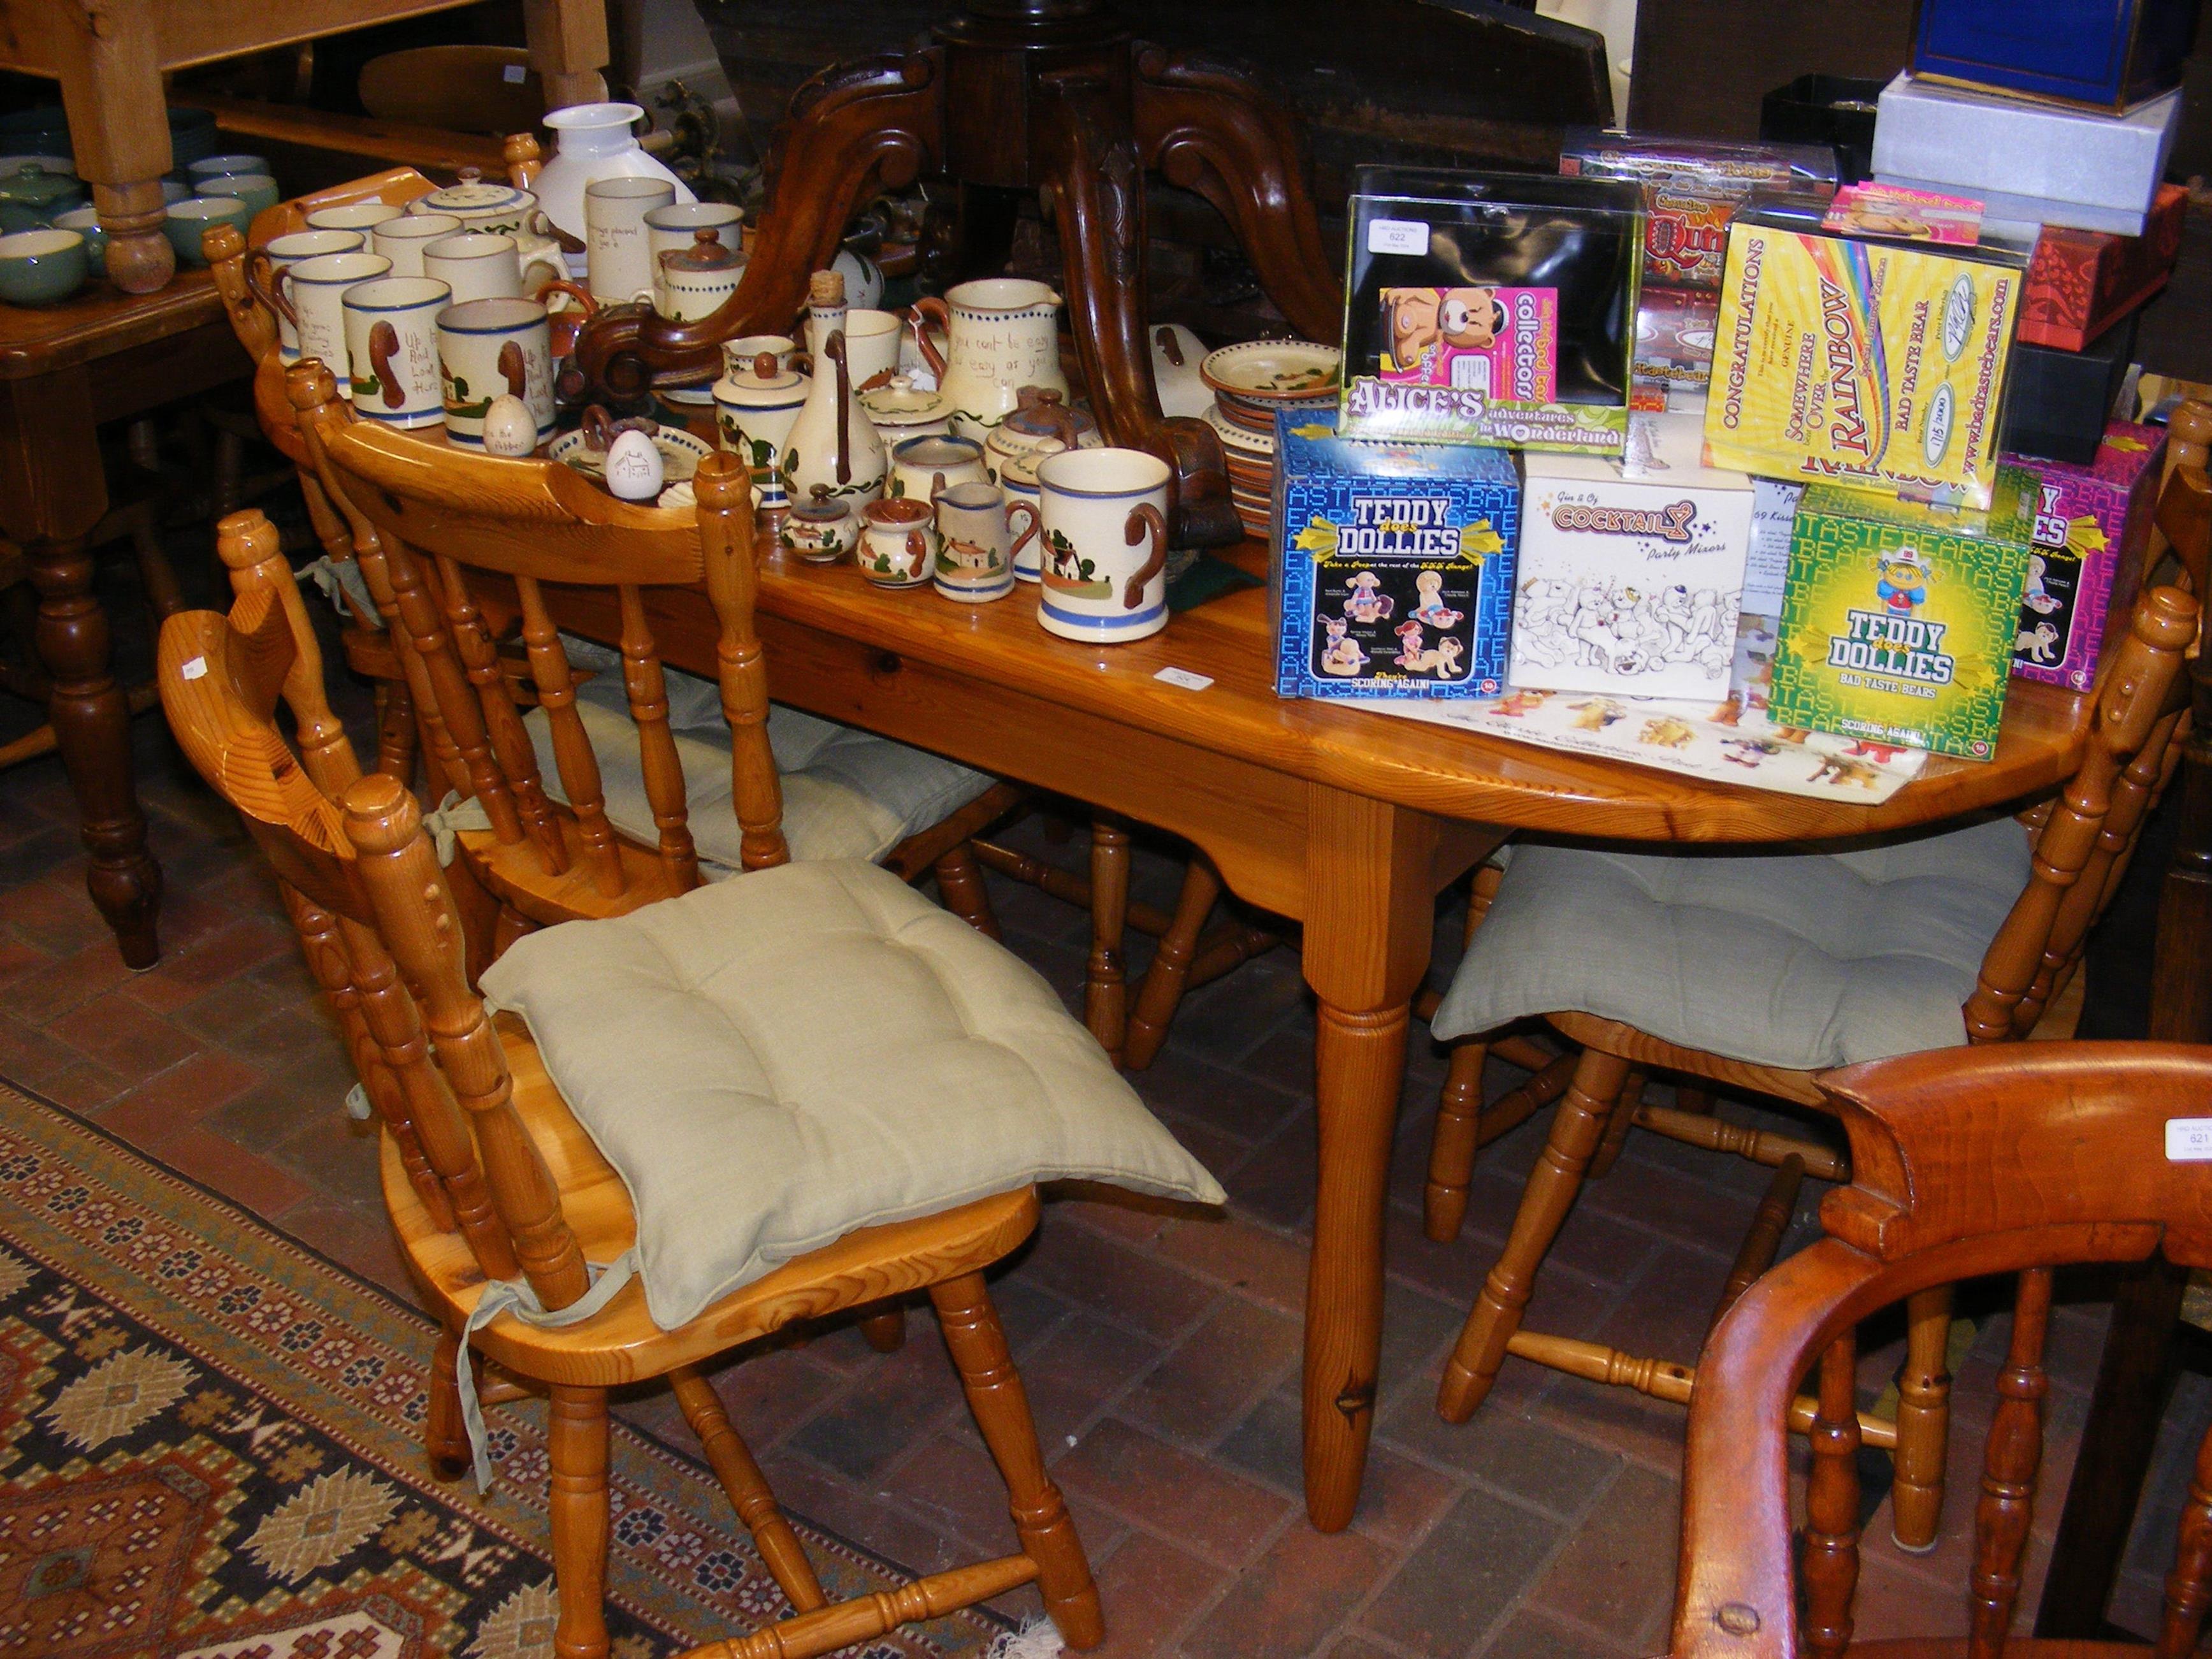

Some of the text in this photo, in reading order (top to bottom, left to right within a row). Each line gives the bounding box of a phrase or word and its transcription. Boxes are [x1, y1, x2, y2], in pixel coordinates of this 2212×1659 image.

[1389, 233, 1406, 241] 622
[1858, 257, 1887, 377] Special Limited Edition
[1515, 293, 1541, 402] collectors
[1723, 238, 1764, 430] CONGRATULATIONS
[1781, 319, 1795, 368] GENUINE
[1420, 352, 1433, 384] offe
[1819, 277, 1867, 456] RAINBOW
[1895, 300, 1930, 431] BAD TASTE BEAR
[1963, 279, 2008, 474] www.badtastebears.com
[1348, 381, 1485, 418] ALICE'S
[1535, 375, 1551, 403] tas
[1785, 333, 1815, 442] SOMEWHERE
[1805, 383, 1826, 430] OVER
[1918, 402, 1929, 428] Number
[1494, 423, 1621, 446] Wonderland
[1557, 491, 1575, 502] Gin
[1577, 494, 1585, 503] &
[1354, 498, 1448, 526] TEDDY
[1378, 516, 1419, 533] does
[1338, 528, 1459, 556] DOLLIES
[1647, 547, 1681, 561] Party
[1850, 611, 1944, 653] TEDDY
[1872, 637, 1912, 655] does
[1830, 639, 1954, 683] DOLLIES
[1351, 677, 1429, 690] SCORING AGAIN!
[1840, 673, 1937, 699] BAD TASTE BEARS
[1841, 718, 1884, 735] SCORING
[2190, 1133, 2208, 1143] 621
